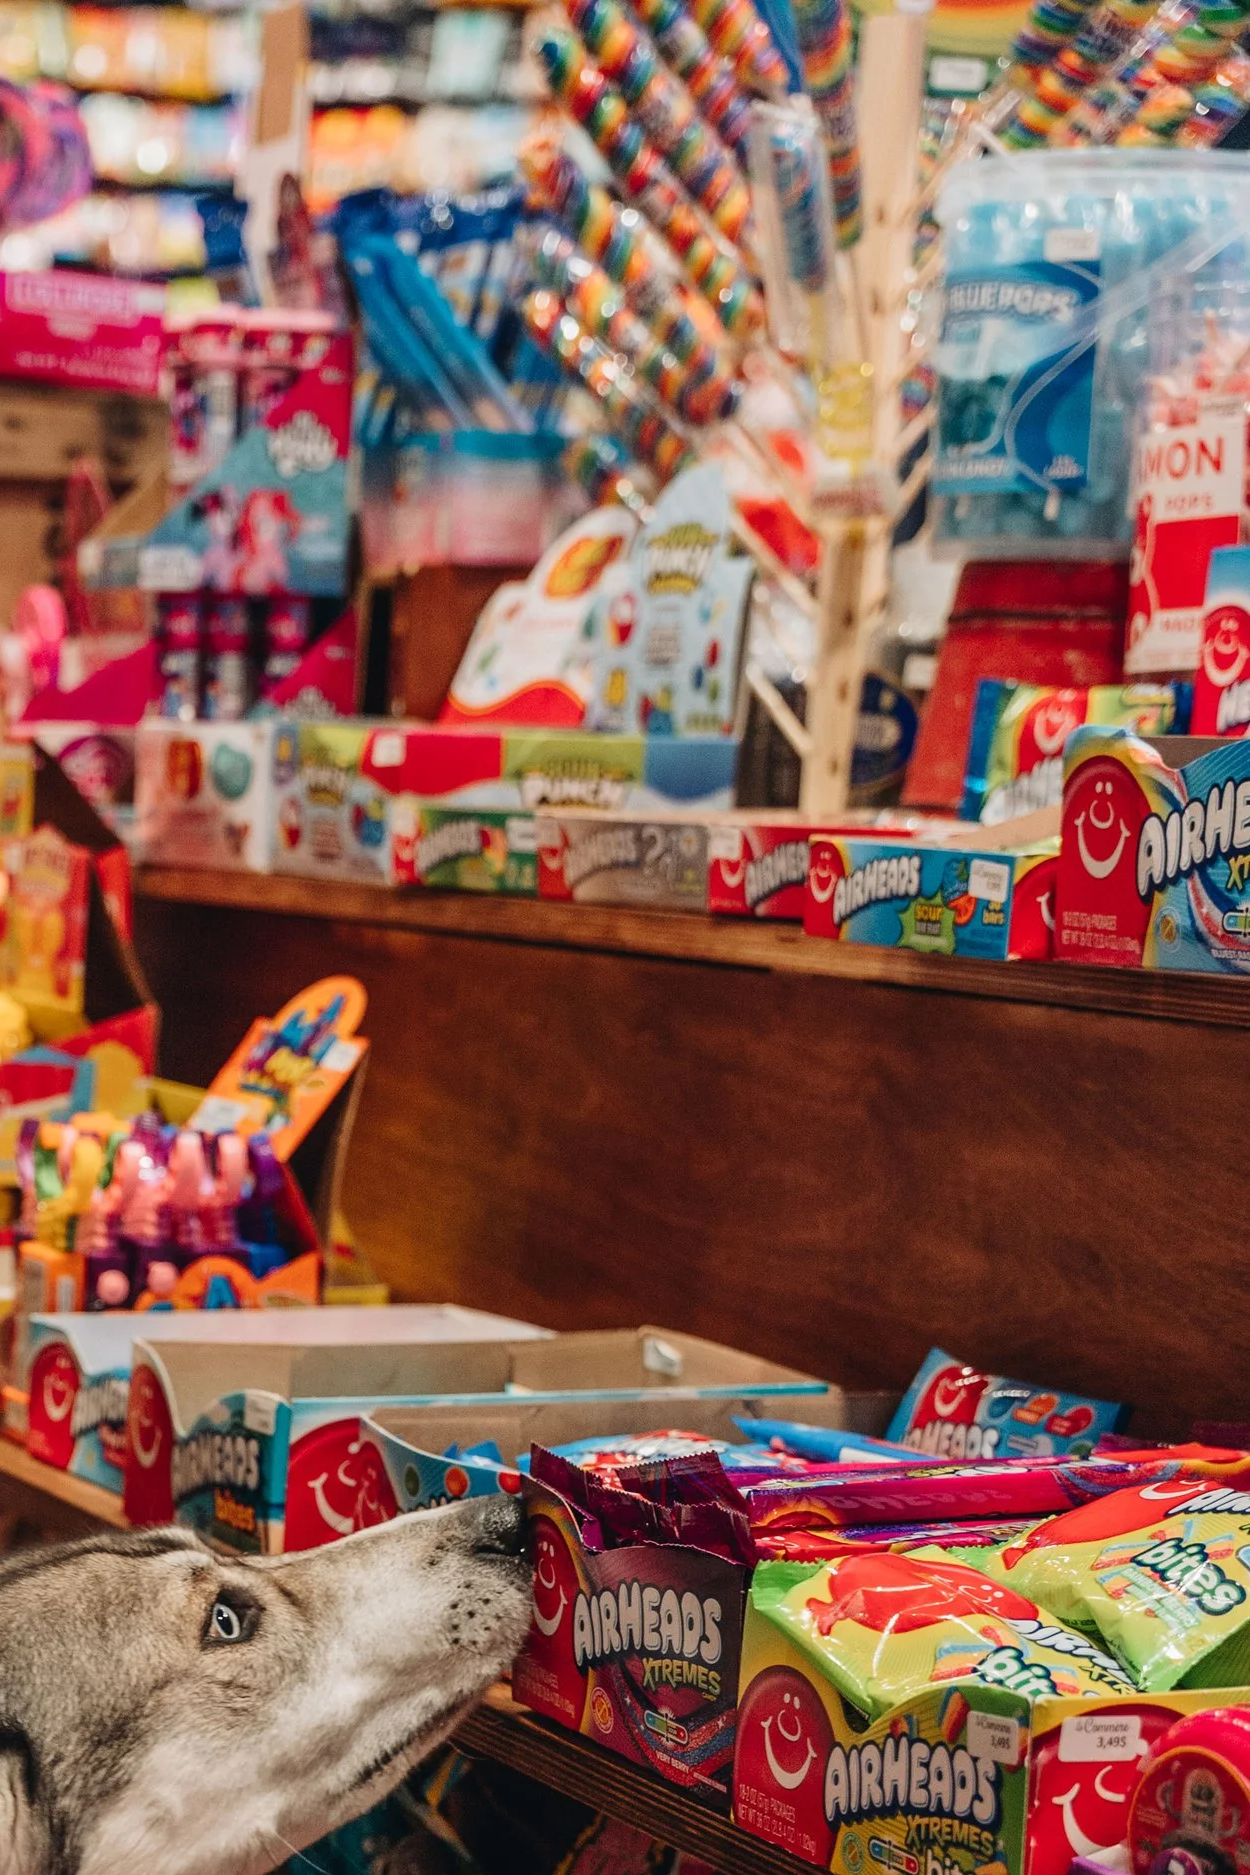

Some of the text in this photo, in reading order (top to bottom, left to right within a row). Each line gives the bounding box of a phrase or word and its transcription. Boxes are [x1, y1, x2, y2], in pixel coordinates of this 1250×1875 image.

[833, 856, 921, 925] AIRHEADS
[172, 1431, 259, 1497] AIRHEADS
[1132, 1541, 1244, 1612] bites
[574, 1582, 721, 1666] AIRHEADS
[642, 1657, 721, 1695] XTREMES
[671, 1758, 690, 1775] BERRY
[1096, 1736, 1128, 1750] 3,49$
[825, 1736, 997, 1823] AIRHEADS
[905, 1815, 995, 1857] XTREMES
